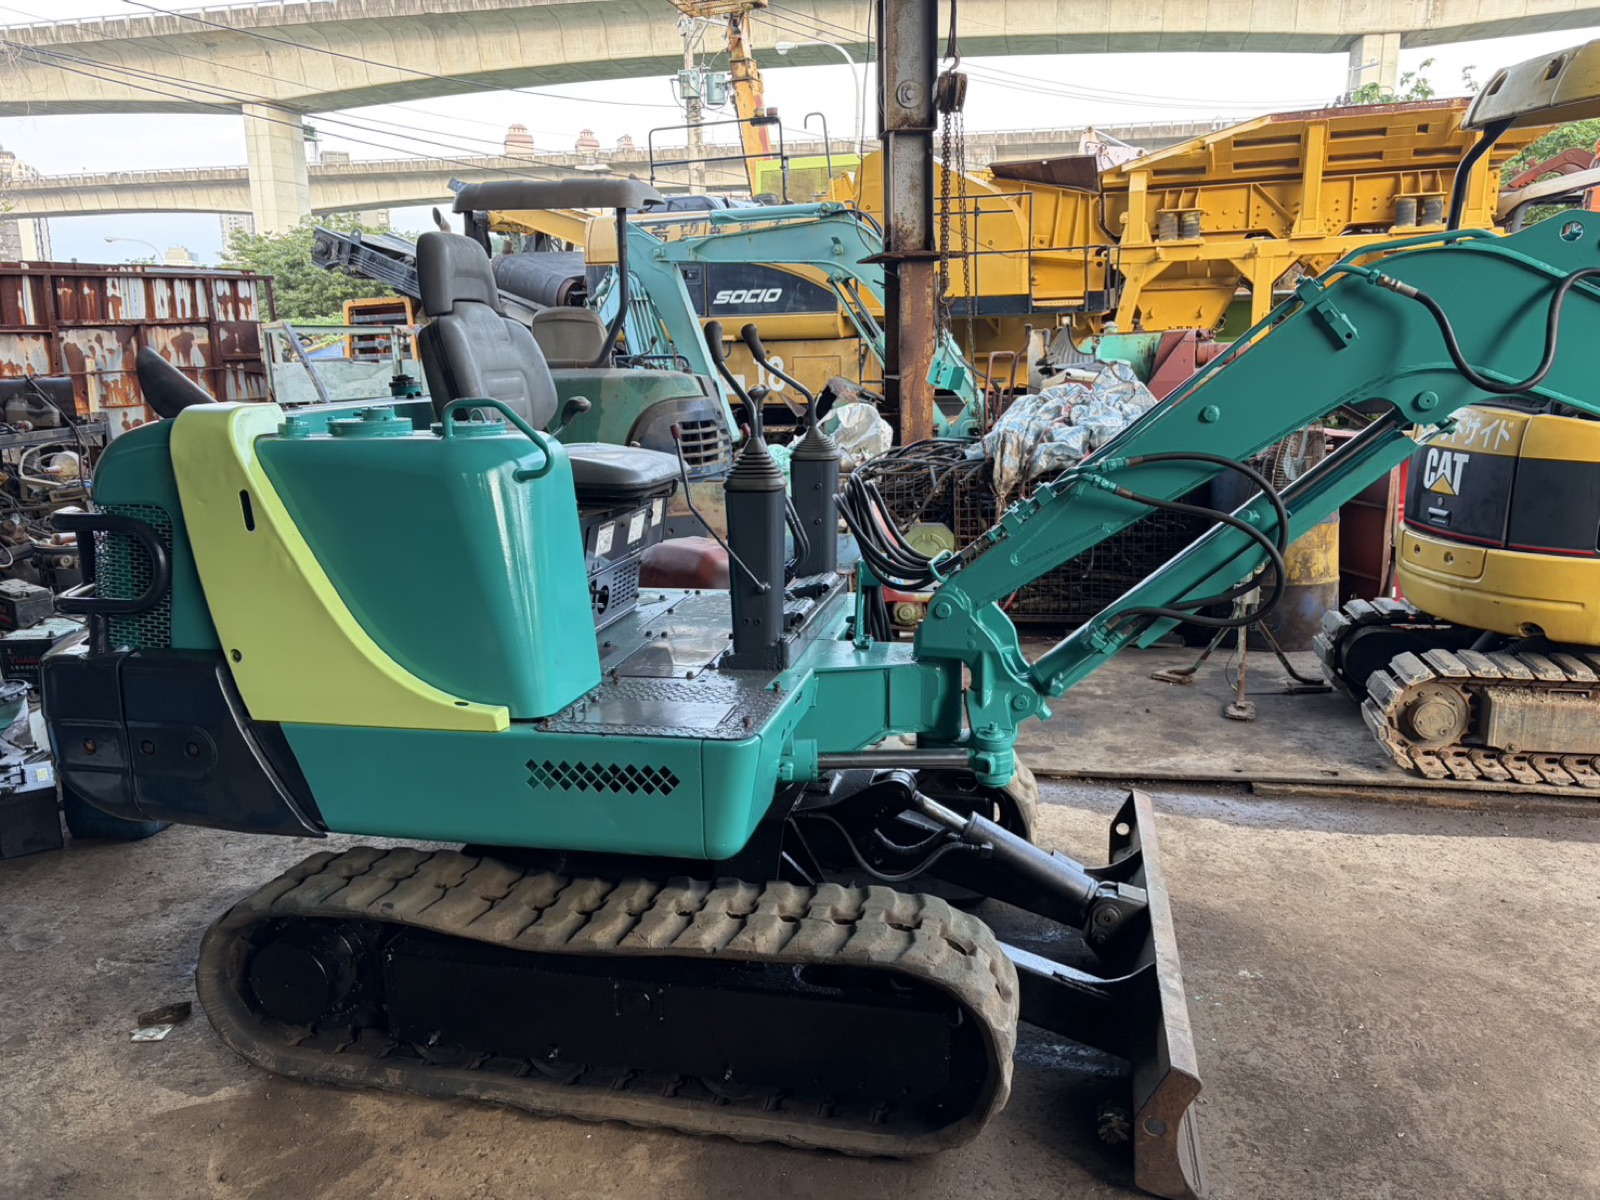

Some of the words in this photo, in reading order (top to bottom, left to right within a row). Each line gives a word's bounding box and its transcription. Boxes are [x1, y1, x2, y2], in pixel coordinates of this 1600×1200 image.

[713, 288, 783, 305] SOCIO
[753, 356, 786, 392] 18
[1423, 448, 1470, 495] CAT
